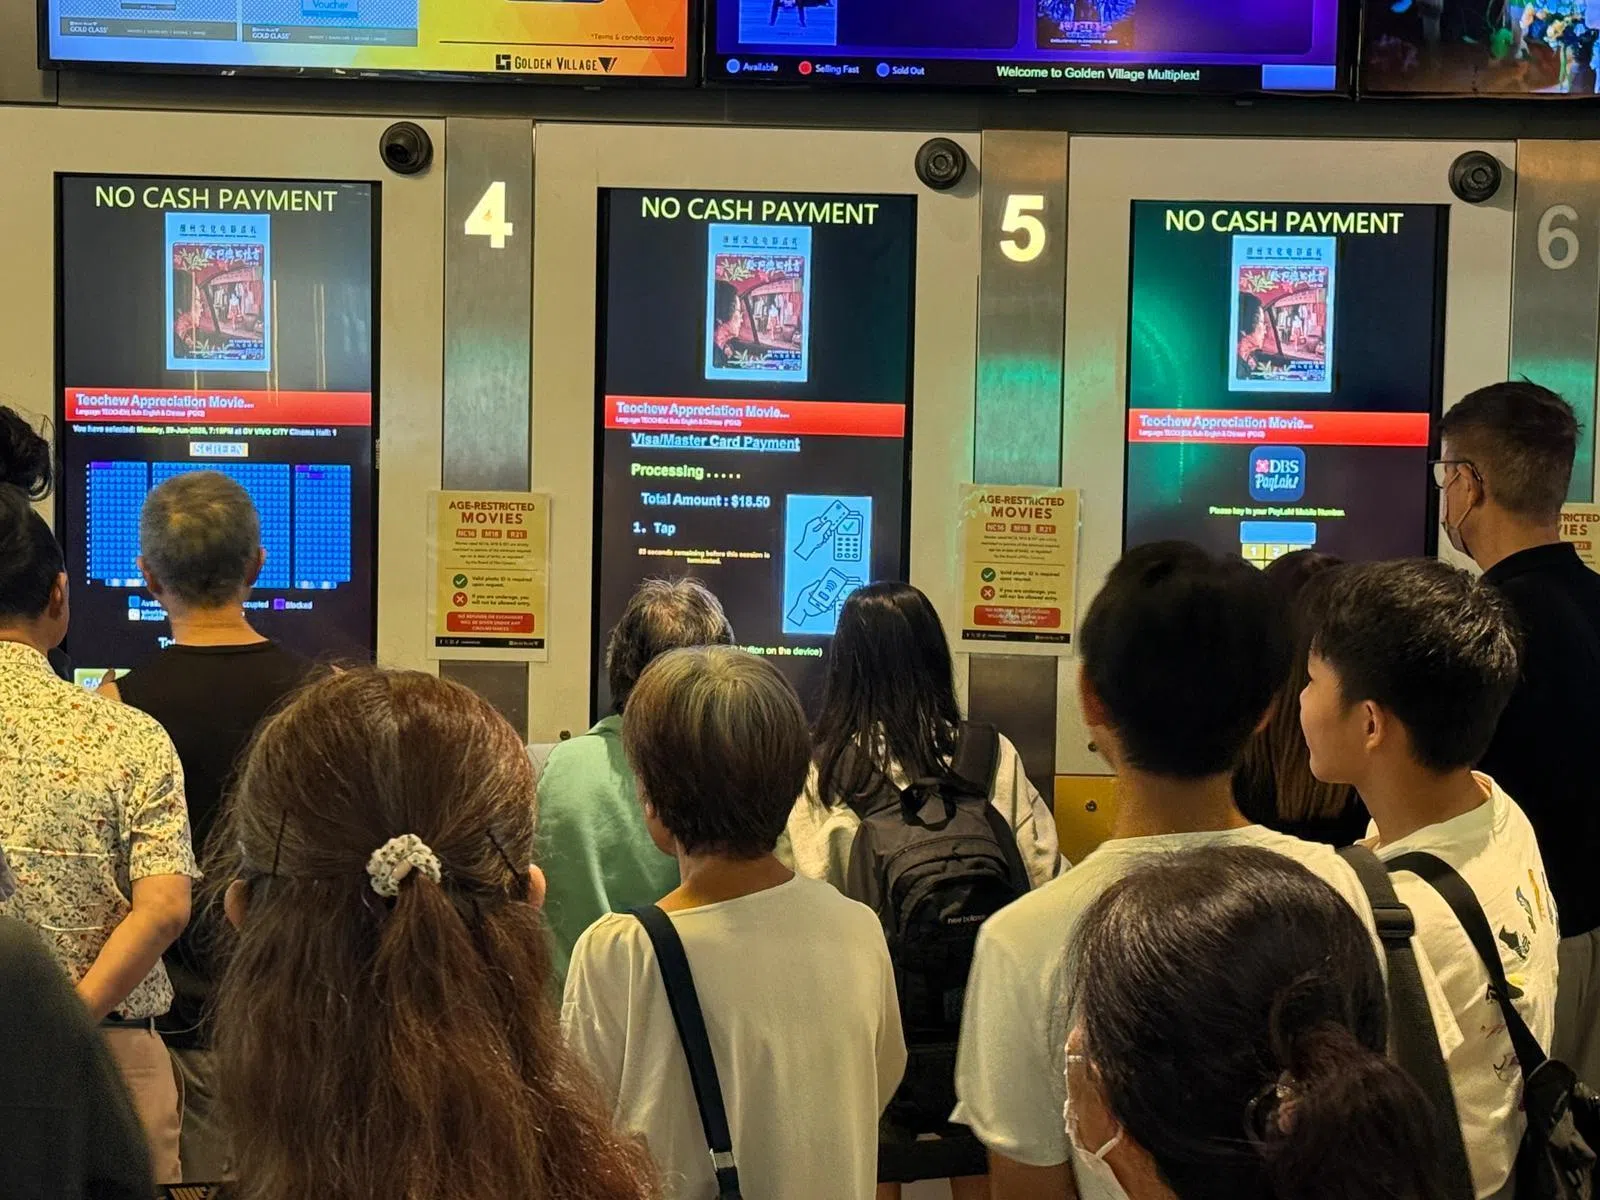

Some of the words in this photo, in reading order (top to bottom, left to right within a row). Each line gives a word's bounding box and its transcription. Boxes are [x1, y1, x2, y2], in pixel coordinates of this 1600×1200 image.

[656, 34, 675, 43] apply
[514, 56, 551, 70] GOLDEN
[556, 57, 598, 71] VILLAGE
[743, 62, 778, 72] Available
[815, 63, 841, 75] Selling
[843, 64, 859, 75] Fast
[892, 65, 908, 75] Sold
[910, 65, 925, 76] Out
[996, 66, 1048, 78] Welcome
[1051, 67, 1062, 78] to
[1064, 67, 1105, 79] Golden
[1107, 68, 1145, 81] Village
[1147, 68, 1200, 82] Multiplex!
[95, 185, 135, 208] NO
[142, 186, 209, 209] CASH
[219, 188, 338, 212] PAYMENT
[464, 181, 513, 249] 4
[641, 196, 681, 219] NO
[687, 197, 753, 221] CASH
[762, 200, 879, 225] PAYMENT
[1000, 195, 1047, 263] 5
[1165, 209, 1205, 232] NO
[1211, 210, 1277, 233] CASH
[1286, 211, 1404, 234] PAYMENT
[1537, 204, 1580, 270] 6
[75, 393, 129, 406] Teochew
[131, 394, 206, 409] Appreciation
[208, 396, 255, 408] Movie...
[615, 401, 669, 414] Teochew
[670, 403, 743, 418] Appreciation
[745, 405, 790, 418] Movie...
[1139, 414, 1193, 427] Teochew
[1193, 416, 1267, 430] Appreciation
[72, 424, 87, 432] You
[88, 425, 104, 433] have
[243, 427, 253, 435] GV
[255, 427, 271, 435] VIVO
[272, 428, 288, 436] CITY
[193, 444, 244, 455] SCREEN
[631, 432, 705, 448] Visa/Master
[709, 435, 741, 449] Card
[743, 437, 801, 452] Payment
[1269, 459, 1299, 473] DBS
[449, 501, 535, 511] AGE-RESTRICTED
[641, 492, 671, 505] Total
[673, 493, 722, 507] Amount
[731, 494, 771, 508] $18.50
[979, 495, 1065, 506] AGE-RESTRICTED
[461, 512, 523, 524] MOVIES
[991, 506, 1052, 519] MOVIES
[633, 521, 646, 533] 1.
[654, 522, 676, 536] Tap
[242, 601, 269, 609] ccupied
[766, 647, 777, 655] on
[778, 646, 792, 655] the
[793, 647, 823, 657] device)
